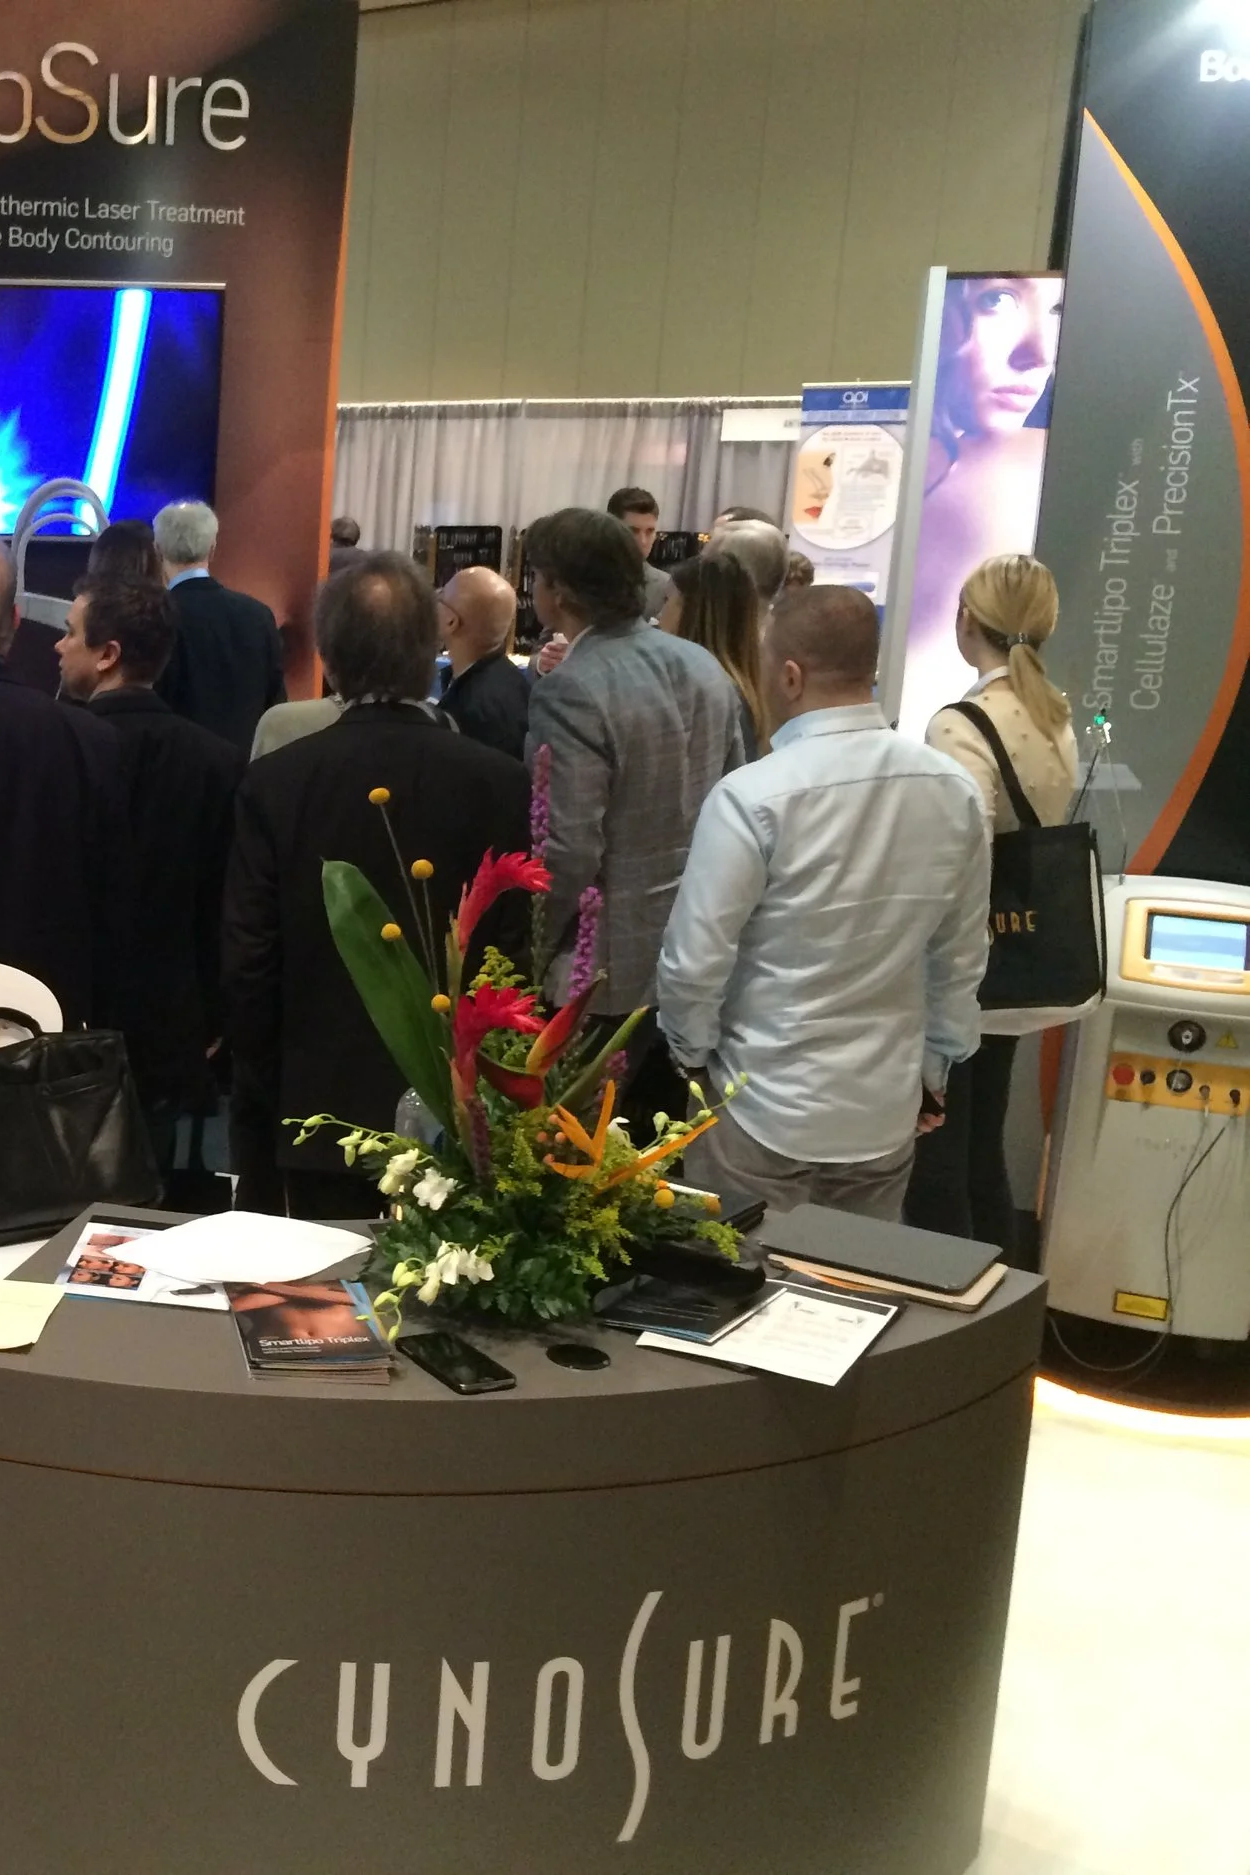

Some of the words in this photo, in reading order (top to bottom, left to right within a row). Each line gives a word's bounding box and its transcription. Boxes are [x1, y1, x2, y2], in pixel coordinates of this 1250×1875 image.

[8, 226, 60, 254] Body
[65, 228, 175, 258] Contouring
[85, 198, 141, 221] Laser
[147, 199, 246, 226] Treatment
[1100, 478, 1141, 572] Triplex
[1129, 583, 1175, 711] Cellulaze
[1152, 376, 1201, 536] PrecisionTx
[1083, 577, 1131, 711] Smartlipo
[991, 910, 1039, 944] URE
[237, 1591, 870, 1842] CYNOSURE
